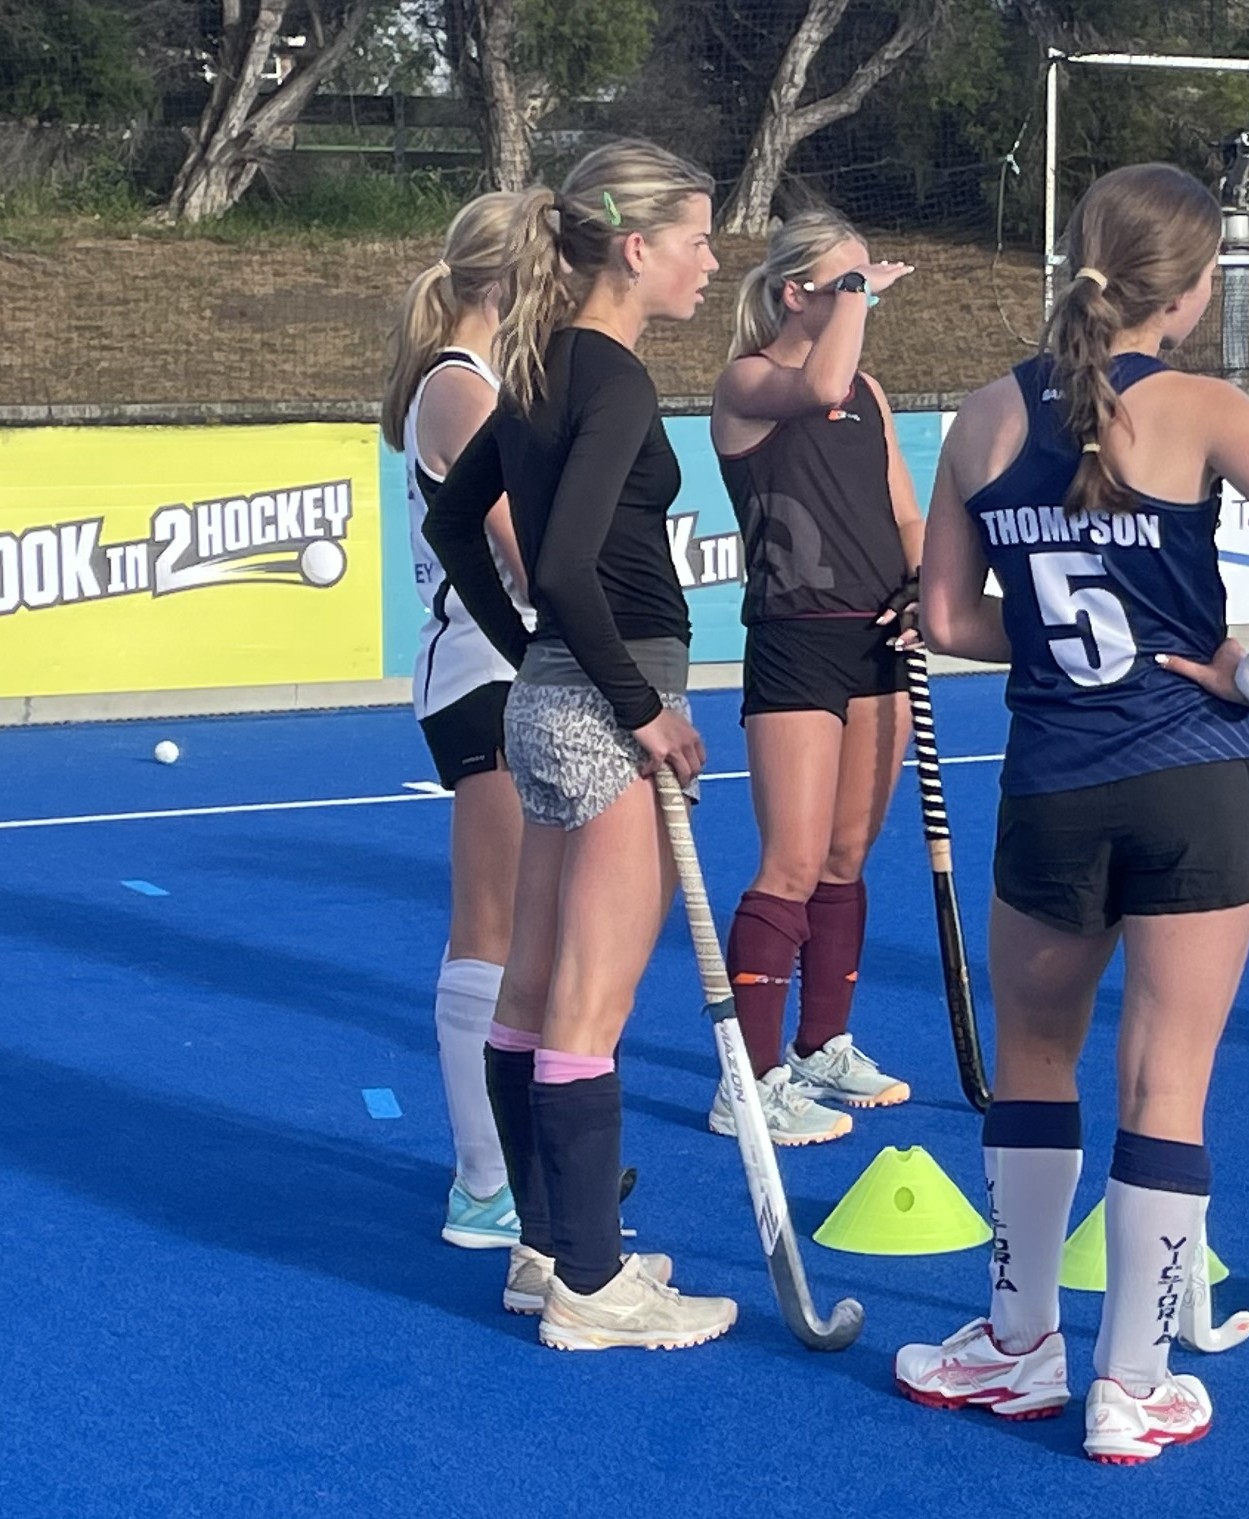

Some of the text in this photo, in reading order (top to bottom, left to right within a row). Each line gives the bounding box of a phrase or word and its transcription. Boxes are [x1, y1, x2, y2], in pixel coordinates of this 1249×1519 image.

[980, 506, 1160, 549] THOMPSON
[1029, 551, 1137, 687] 5
[1153, 1236, 1187, 1346] VICTORIA
